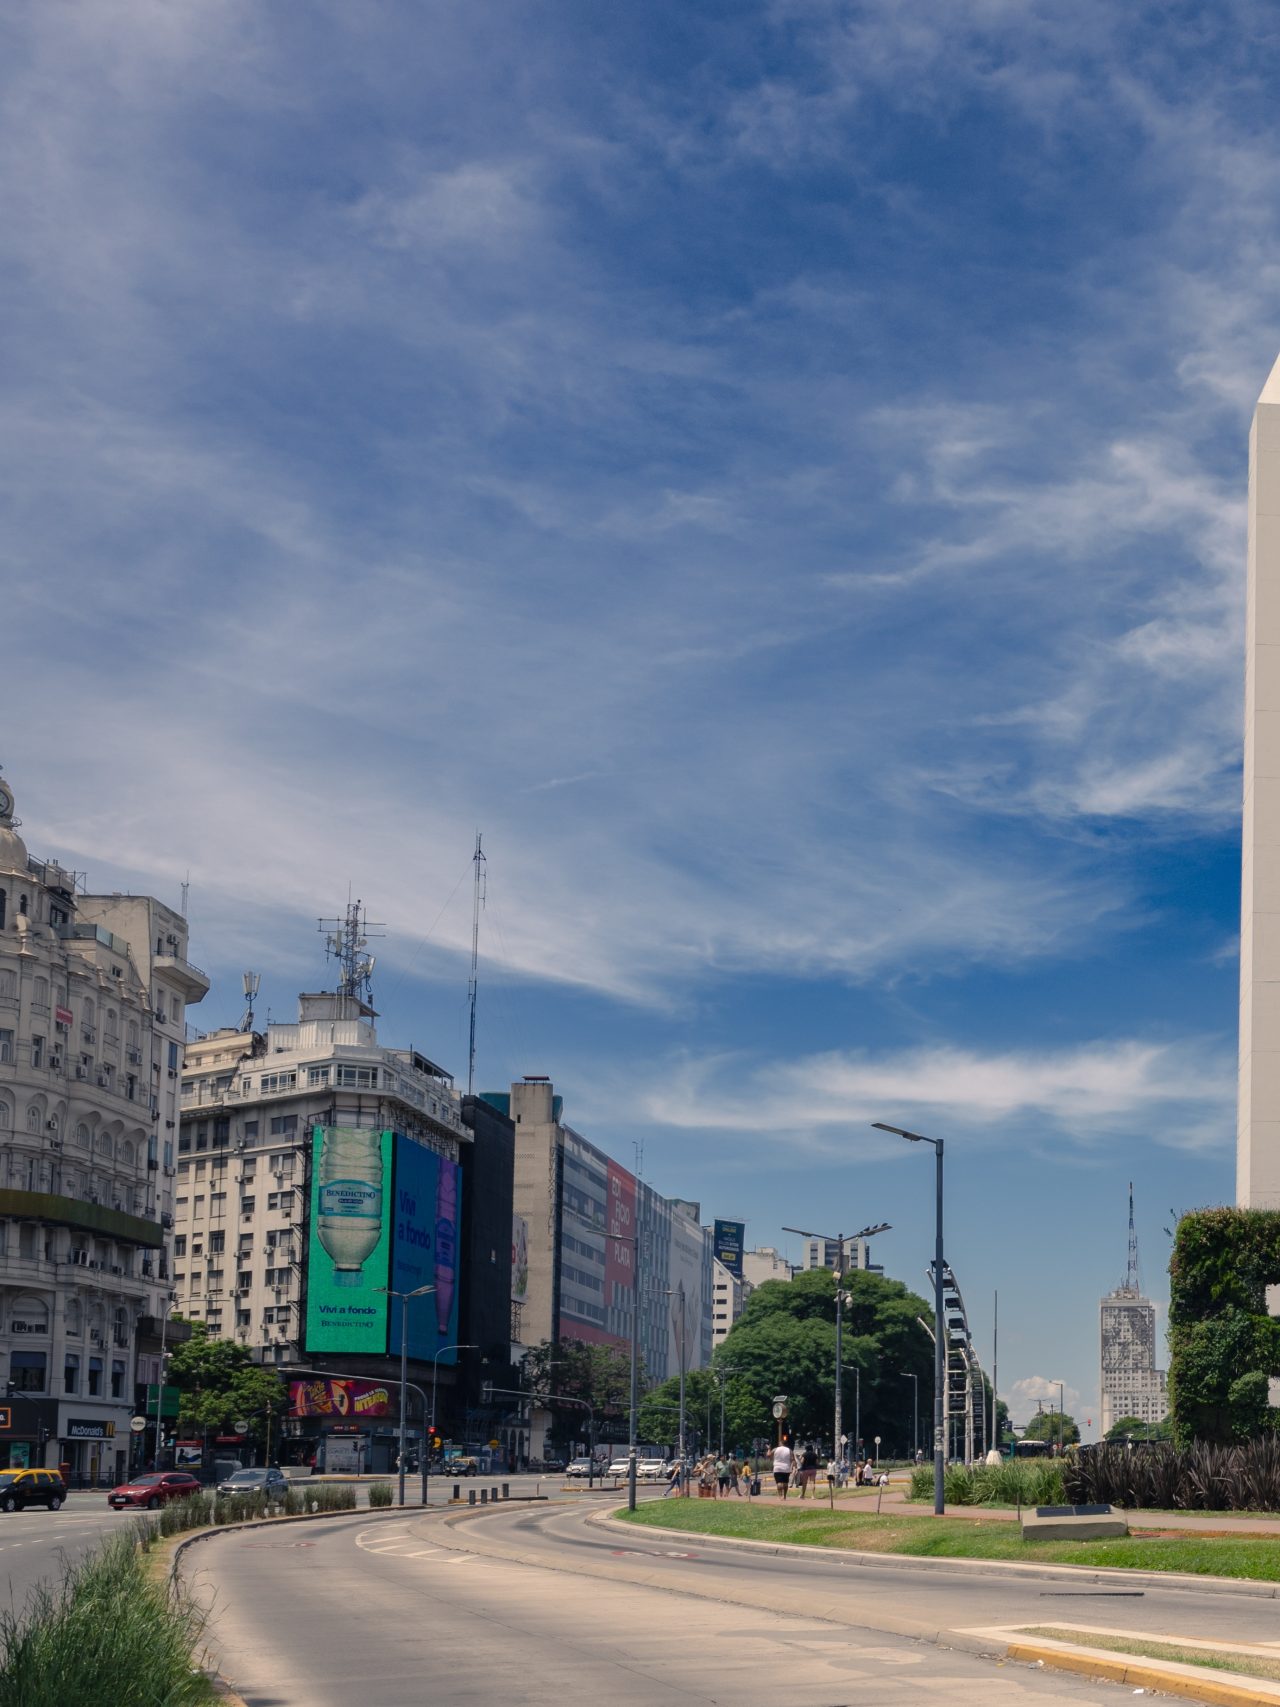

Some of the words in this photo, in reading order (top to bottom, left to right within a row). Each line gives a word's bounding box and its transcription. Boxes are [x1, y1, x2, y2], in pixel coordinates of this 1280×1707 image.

[326, 1189, 376, 1200] BENEDICTINO
[612, 1175, 622, 1199] EDI
[615, 1199, 630, 1226] FICIO
[407, 1219, 430, 1250] fondo
[614, 1242, 630, 1269] PLATA
[348, 1304, 377, 1315] fondo
[321, 1320, 374, 1329] BENEDICTINO
[71, 1425, 104, 1437] McDonald's
